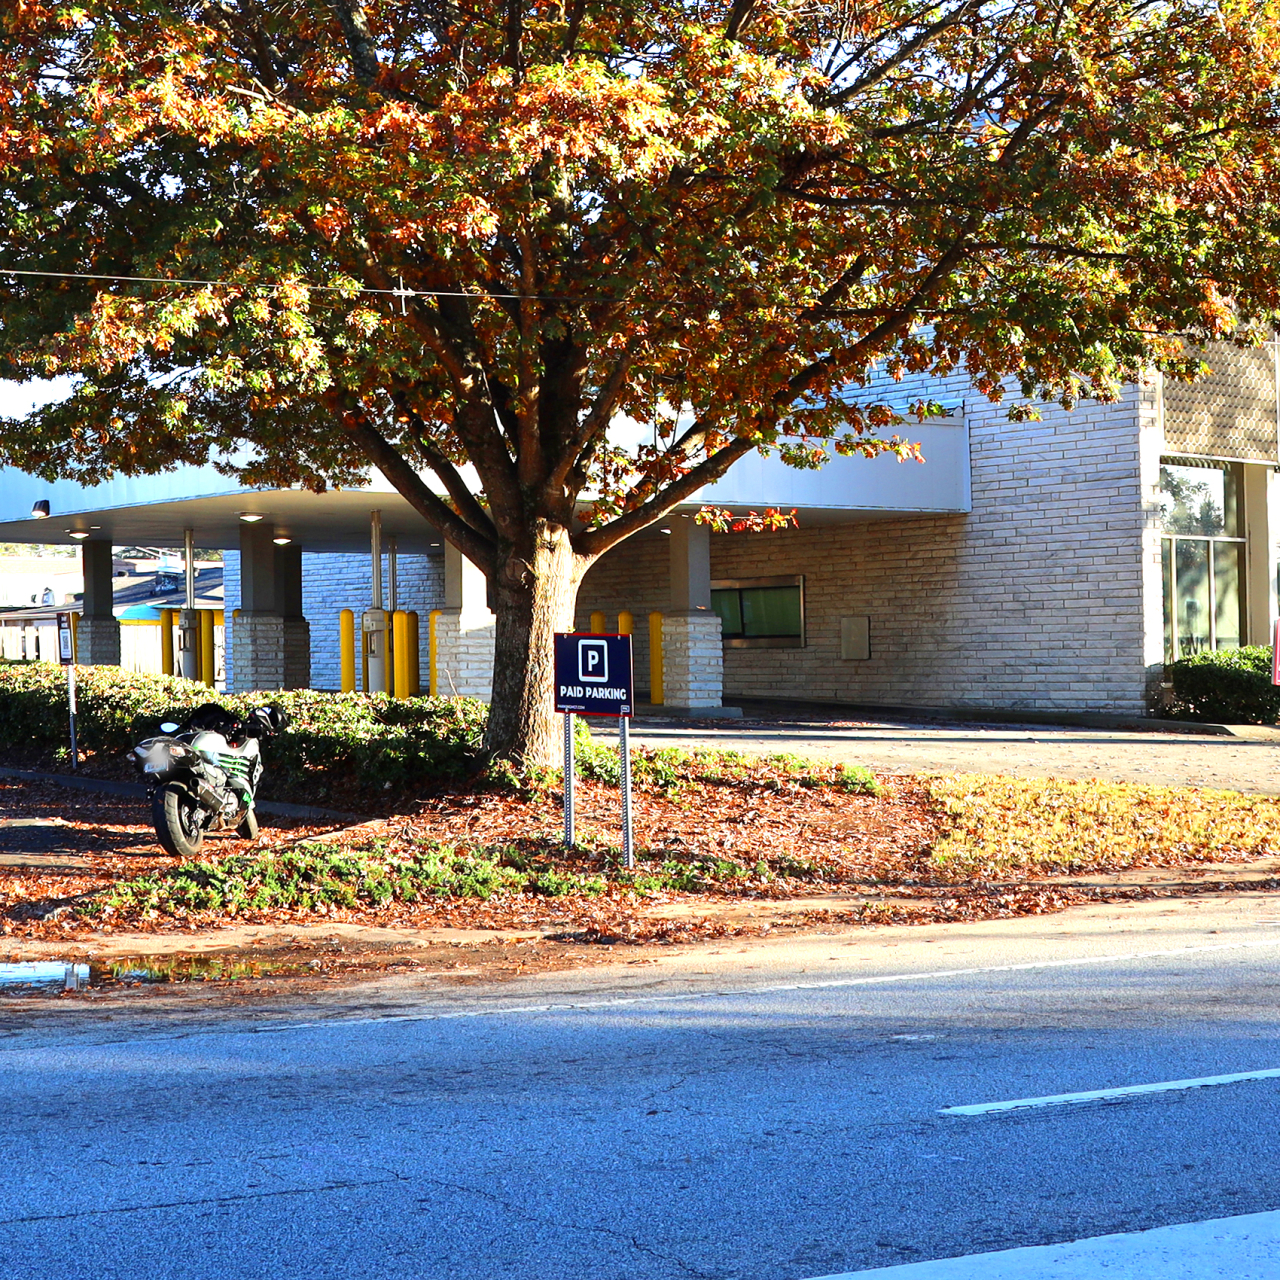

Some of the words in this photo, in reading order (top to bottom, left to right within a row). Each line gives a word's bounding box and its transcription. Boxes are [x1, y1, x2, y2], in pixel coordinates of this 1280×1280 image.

[588, 650, 599, 671] P
[560, 686, 584, 697] PAID
[586, 687, 627, 700] PARKING
